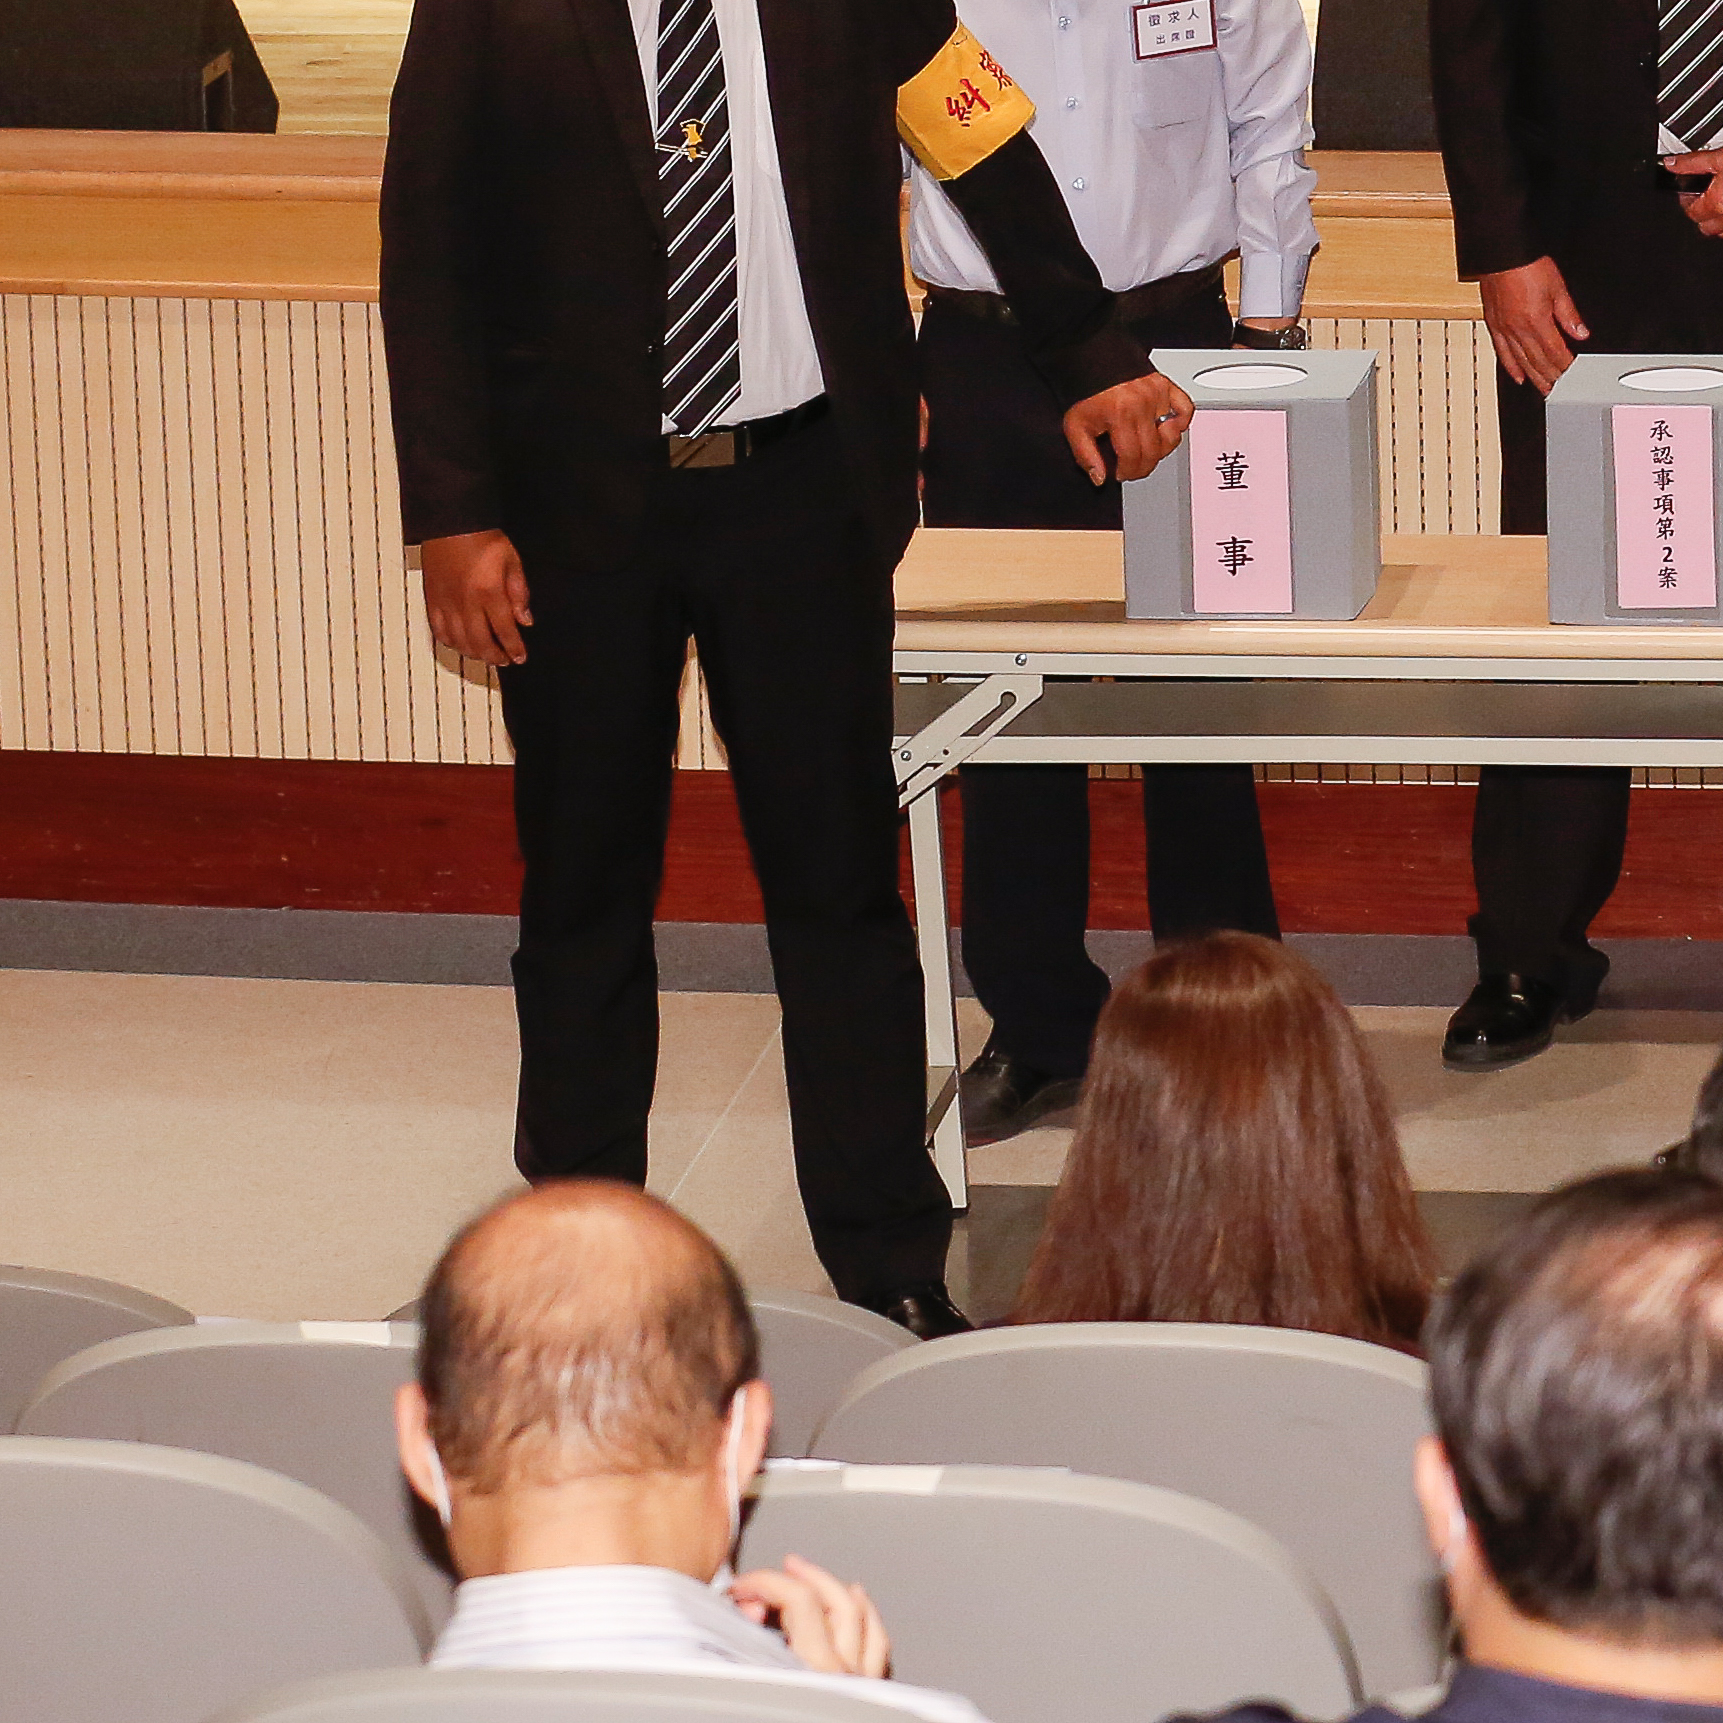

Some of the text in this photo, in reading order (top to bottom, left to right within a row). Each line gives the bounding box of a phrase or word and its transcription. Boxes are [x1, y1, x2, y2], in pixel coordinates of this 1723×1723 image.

[1215, 450, 1255, 577] 董事
[1649, 419, 1679, 589] 承認事項第2案
